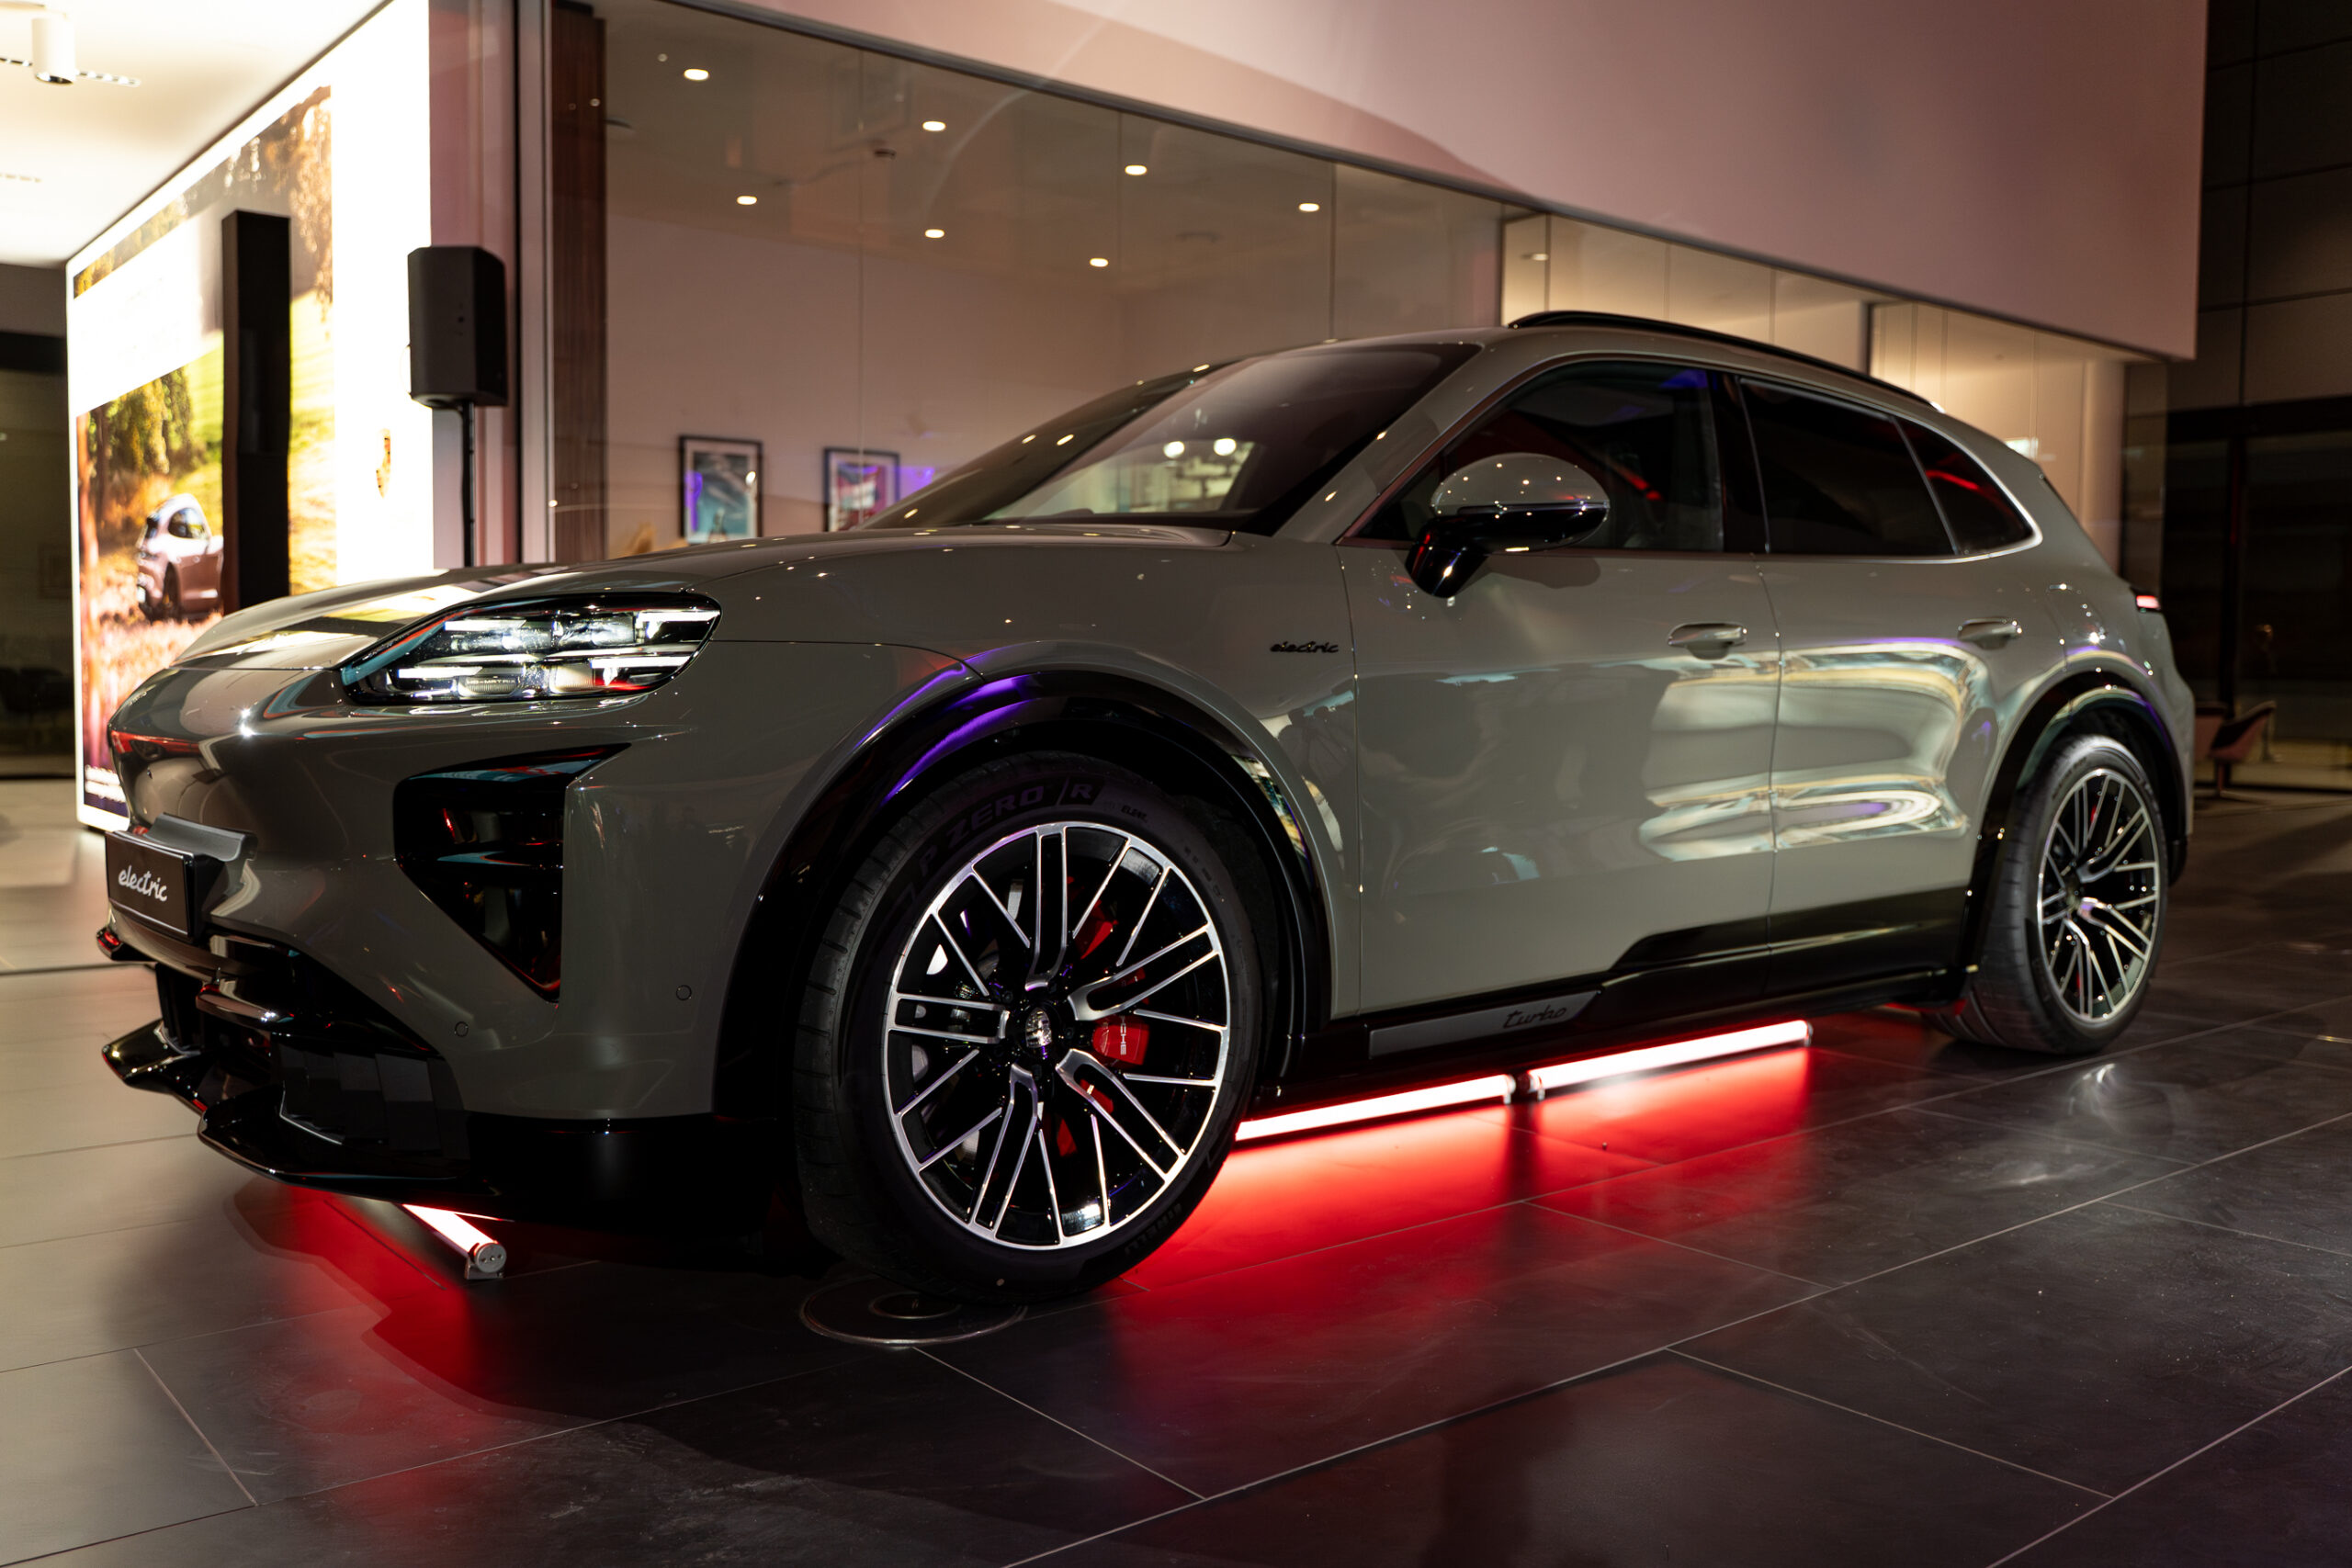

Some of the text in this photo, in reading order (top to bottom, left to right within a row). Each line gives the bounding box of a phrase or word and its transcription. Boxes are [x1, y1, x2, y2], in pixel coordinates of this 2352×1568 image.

[1270, 641, 1340, 653] electric
[946, 785, 1045, 847] ZERO
[1069, 782, 1094, 800] R
[118, 864, 168, 902] electric
[1502, 1004, 1568, 1029] turbo
